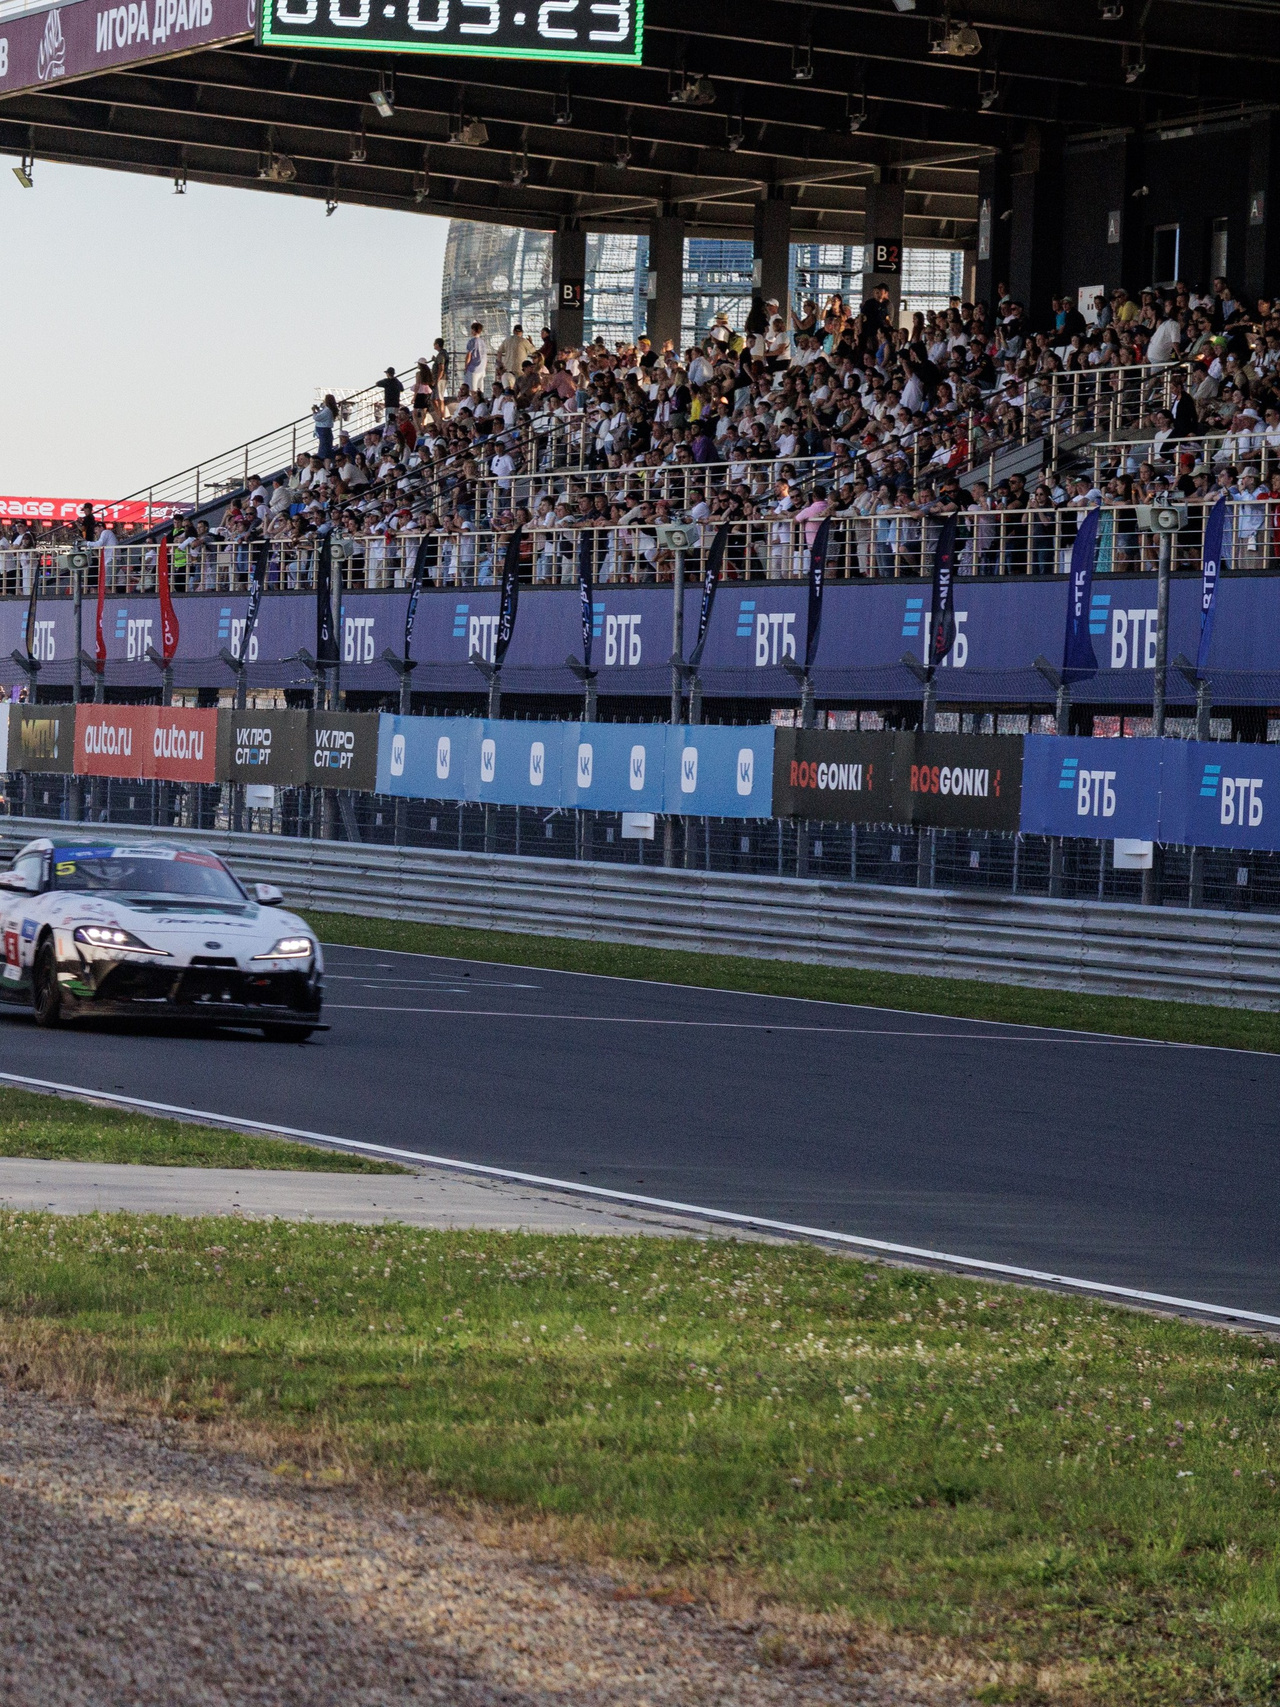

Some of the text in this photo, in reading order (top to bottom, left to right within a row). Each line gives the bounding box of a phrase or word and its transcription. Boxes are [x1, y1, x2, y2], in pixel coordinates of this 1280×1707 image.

[96, 0, 149, 53] ИГОРА
[877, 245, 899, 262] B2
[32, 621, 56, 661] ВТБ
[127, 619, 153, 661] ВТБ
[344, 618, 376, 664] ВТБ
[605, 615, 642, 666] ВТБ
[755, 613, 796, 667] ВТБ
[84, 721, 132, 756] auto.ru
[153, 724, 205, 760] auto.ru
[235, 747, 271, 765] СПОРТ
[314, 749, 354, 769] СПОРТ
[394, 746, 403, 765] VK
[439, 749, 448, 768] VK
[483, 751, 493, 771] VK
[532, 755, 542, 774] VK
[580, 756, 590, 776] VK
[633, 759, 643, 778] VK
[684, 760, 695, 780] VK
[740, 762, 751, 783] VK
[790, 760, 862, 791] ROSGONKI
[910, 764, 989, 797] ROSGONKI
[1077, 769, 1116, 817] ВТБ
[1220, 777, 1263, 827] ВТБ
[55, 860, 77, 876] 5
